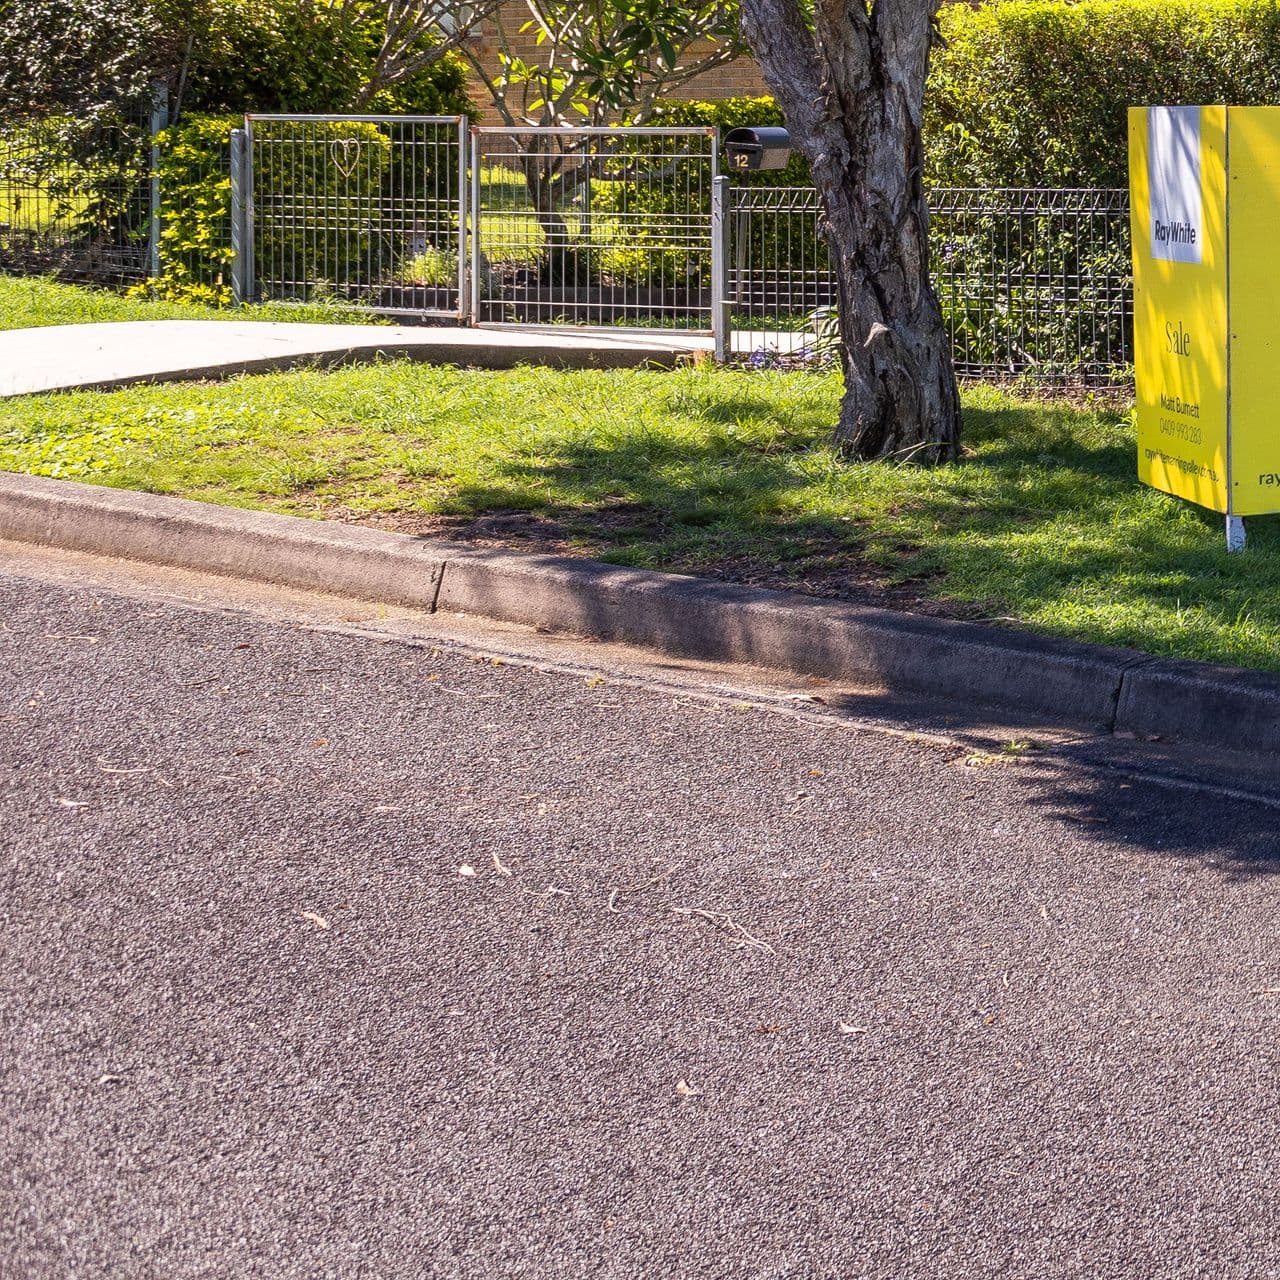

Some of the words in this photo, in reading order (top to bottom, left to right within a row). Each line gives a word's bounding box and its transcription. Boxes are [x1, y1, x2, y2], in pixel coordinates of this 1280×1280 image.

[734, 154, 749, 168] 12
[1165, 320, 1191, 357] Sale
[1160, 392, 1176, 412] Matt
[1176, 397, 1200, 419] Burnett
[1160, 417, 1175, 436] 0409
[1176, 422, 1189, 441] 993
